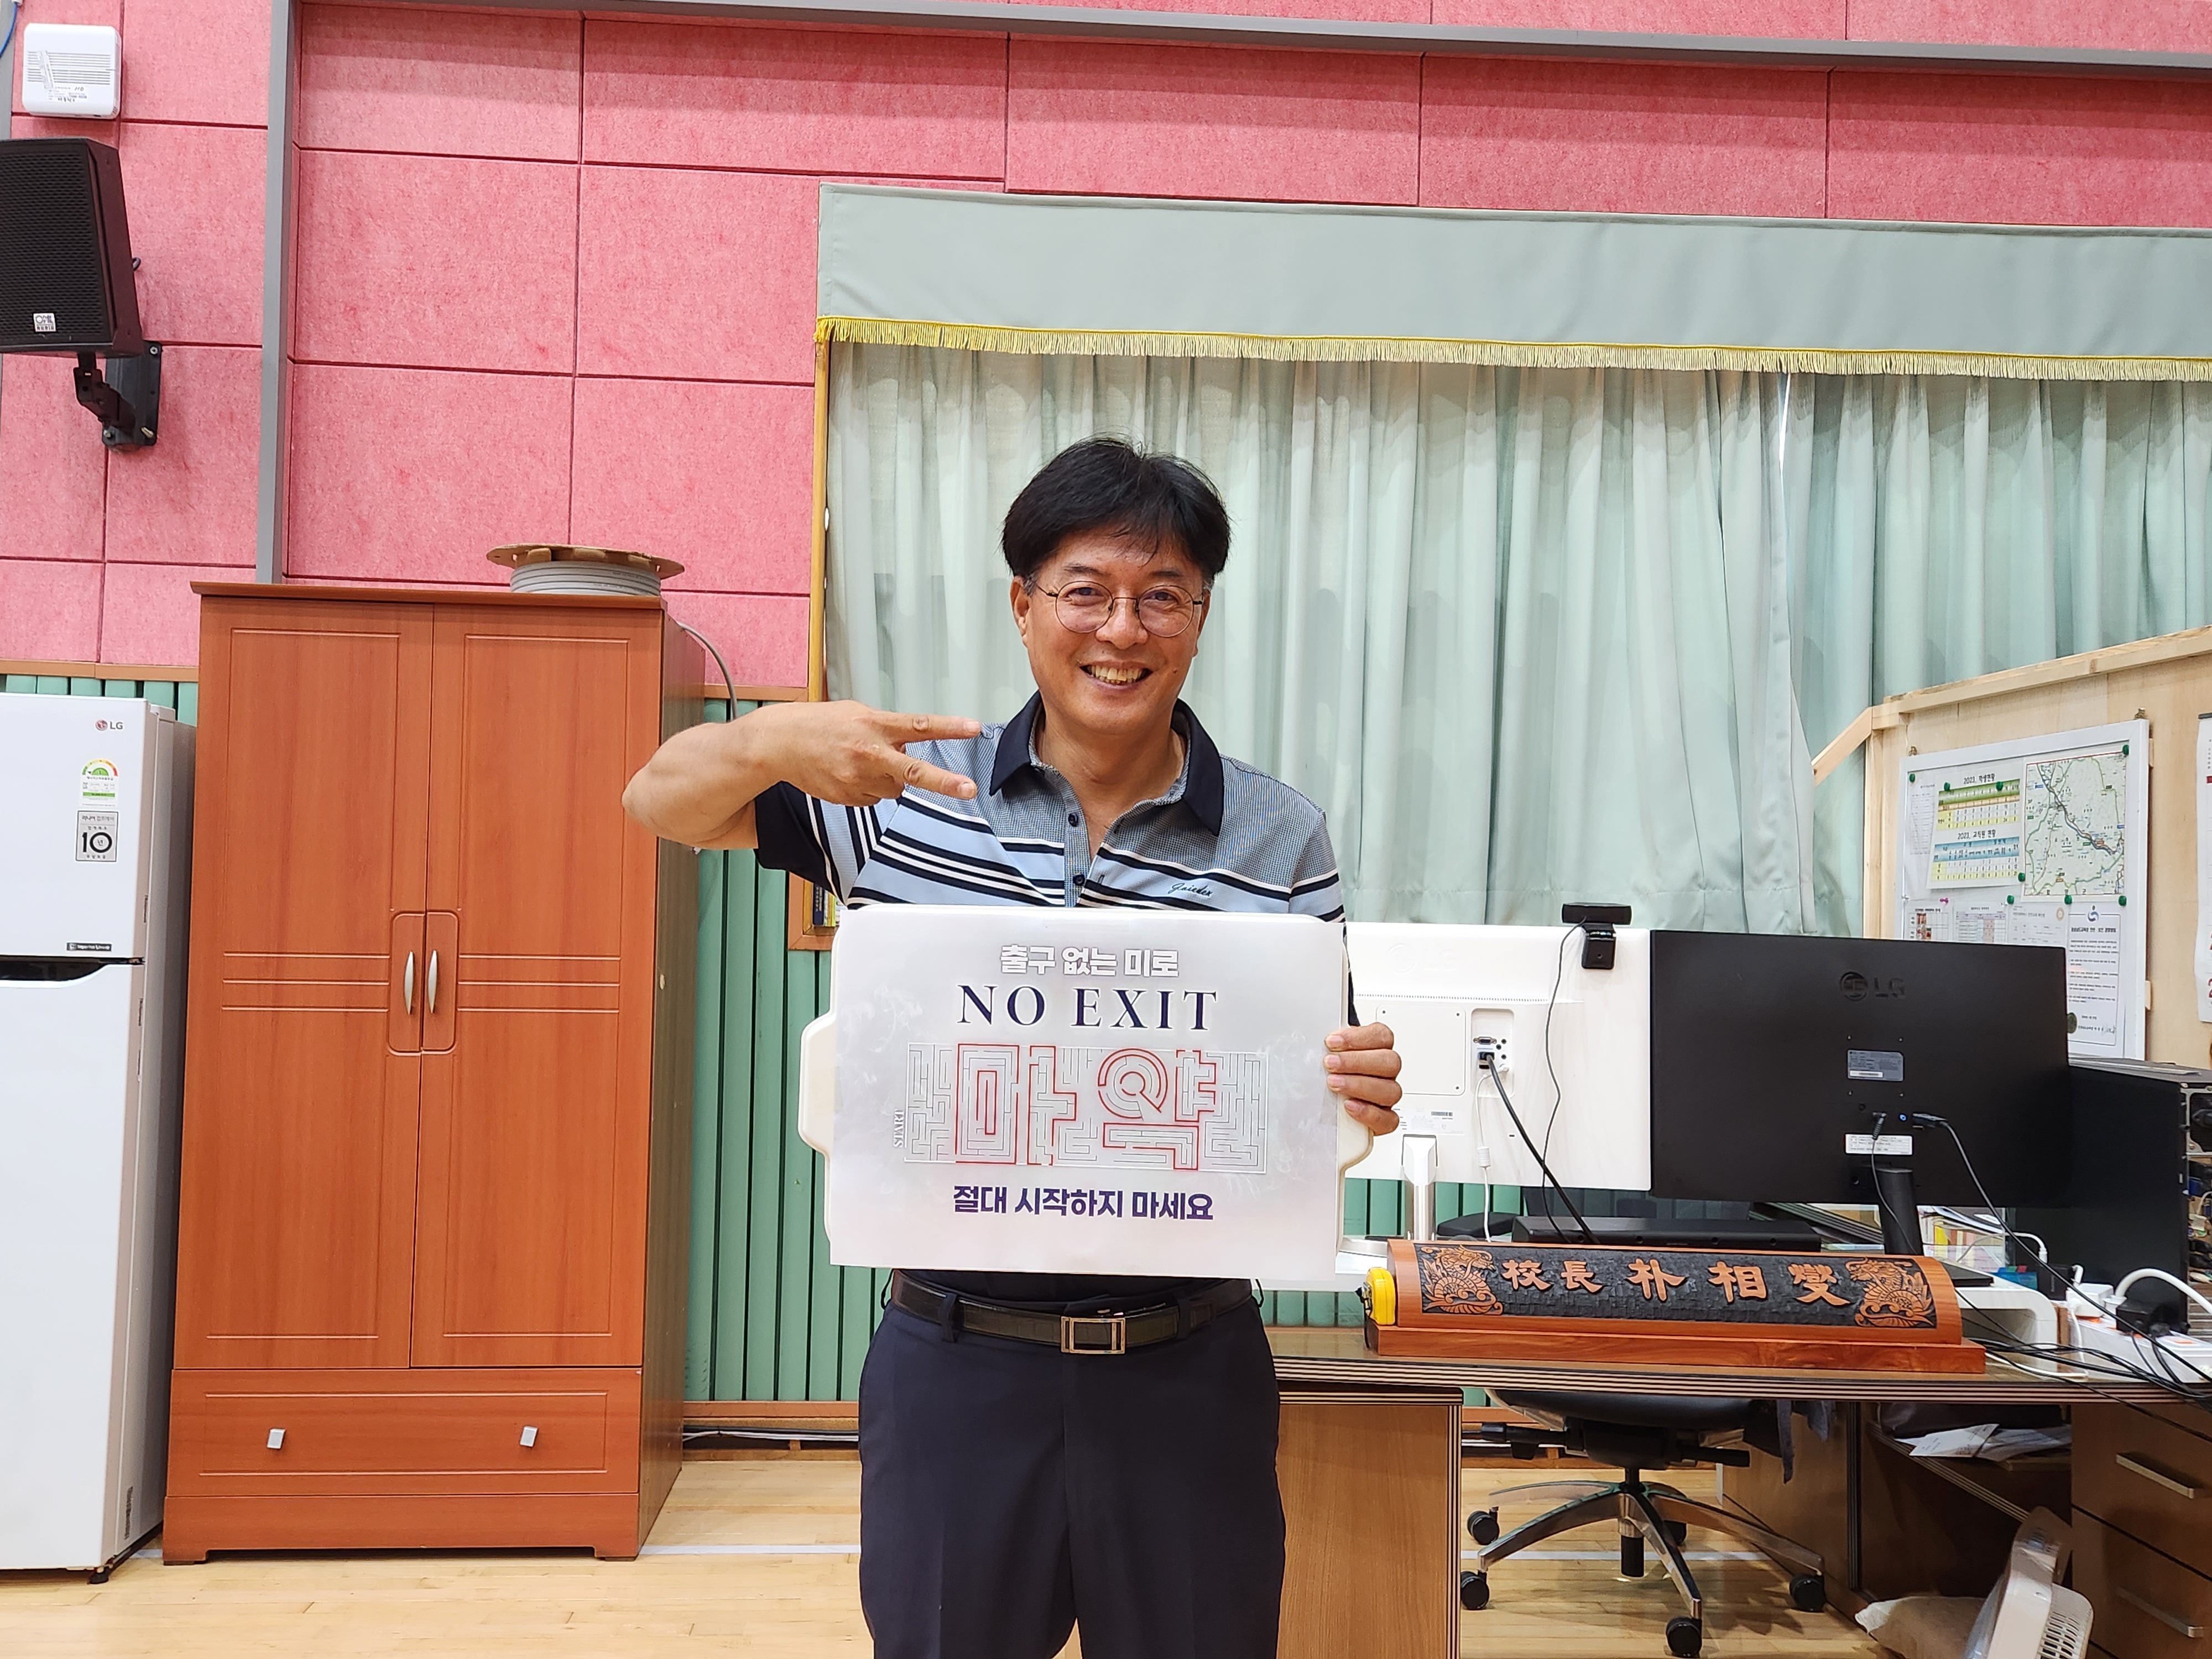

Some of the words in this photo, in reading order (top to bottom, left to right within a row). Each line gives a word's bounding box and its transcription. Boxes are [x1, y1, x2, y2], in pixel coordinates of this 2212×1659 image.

[109, 721, 123, 730] LG
[82, 832, 113, 853] 10
[1000, 945, 1056, 975] 출구
[1061, 947, 1118, 977] 없는
[1124, 949, 1179, 977] 미로
[957, 985, 1045, 1026] NO
[1070, 988, 1217, 1030] EXIT
[893, 1109, 904, 1148] START
[953, 1185, 1008, 1214] 절대
[1014, 1187, 1123, 1218] 시작하지
[1131, 1192, 1214, 1220] 마세요
